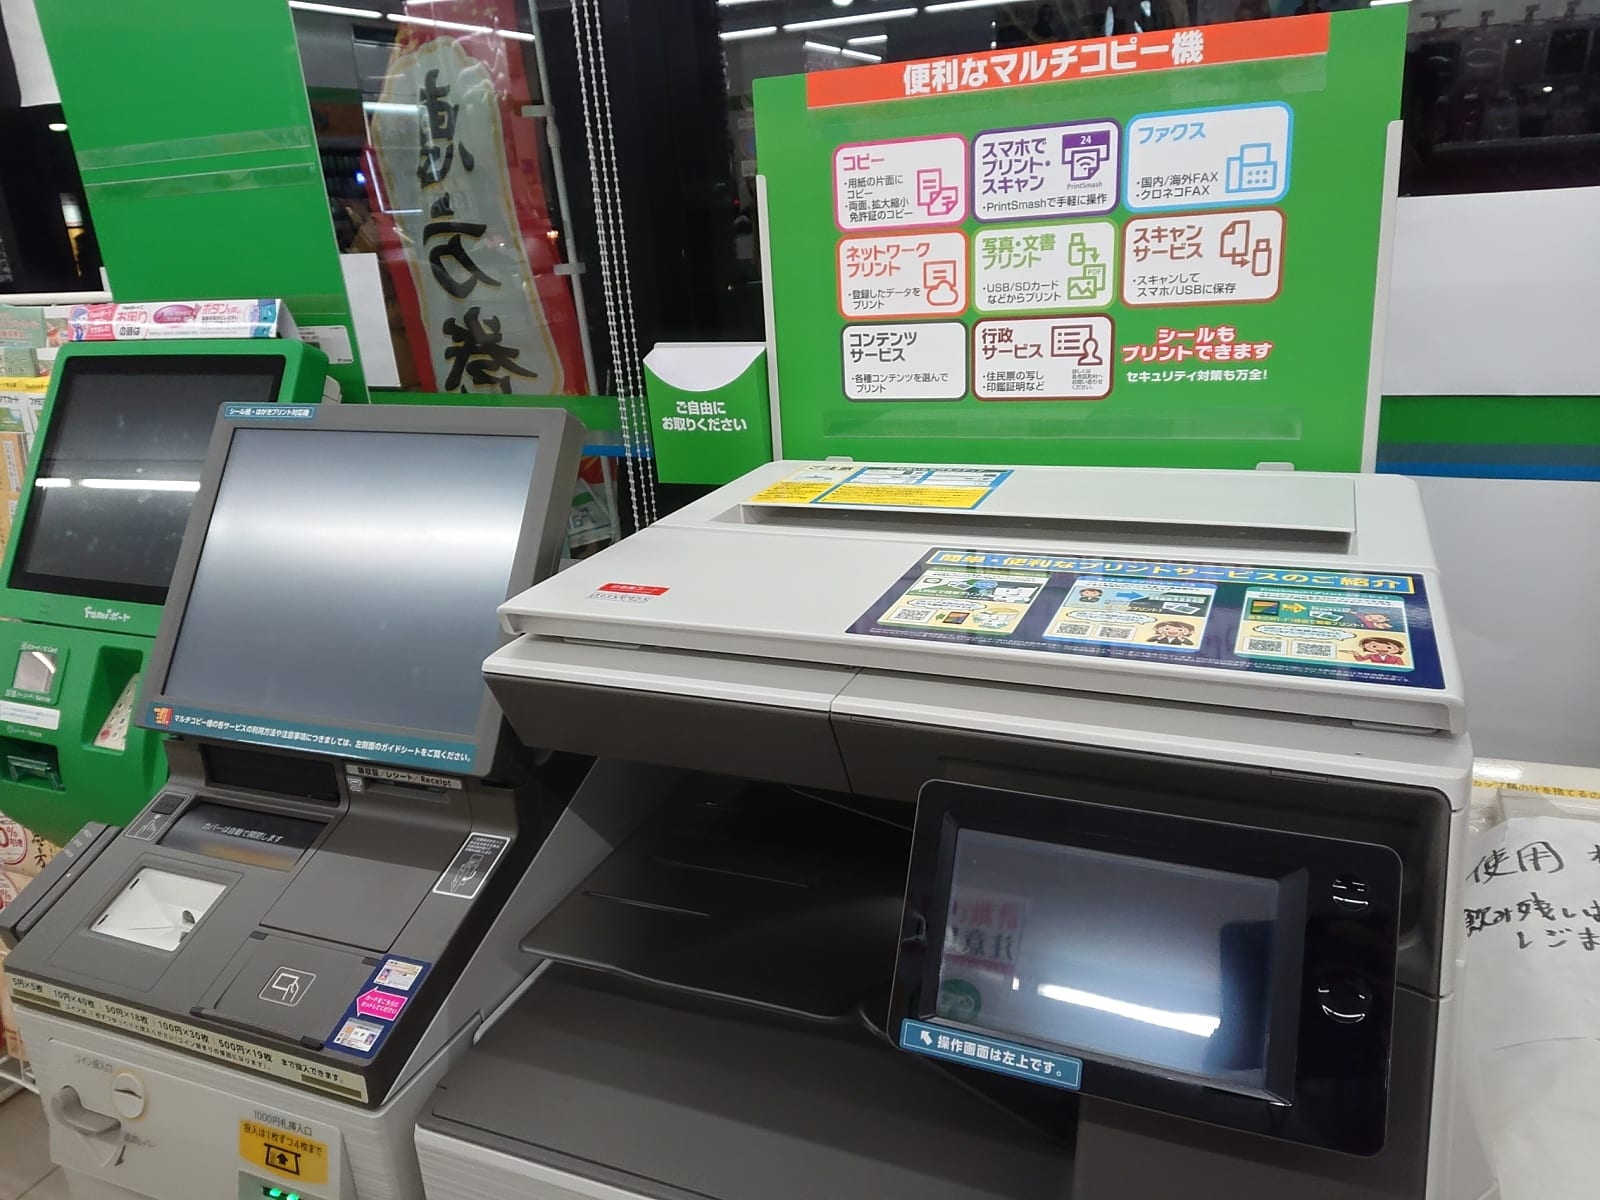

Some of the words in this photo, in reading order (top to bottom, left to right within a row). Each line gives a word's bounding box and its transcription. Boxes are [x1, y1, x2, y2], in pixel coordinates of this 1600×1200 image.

[903, 29, 1204, 96] 便利なマルチコピー機
[1080, 135, 1092, 145] 24
[1137, 122, 1206, 145] ファクス
[982, 137, 1047, 159] スマホで
[843, 153, 885, 171] コピー
[847, 189, 873, 199] コピー
[982, 175, 1045, 195] スキャン
[849, 208, 913, 223] 免許証のコピー
[1133, 224, 1203, 244] スキャン
[846, 242, 931, 262] ネットワーク
[982, 233, 1056, 255] 写真・文書
[1133, 242, 1204, 262] サービス
[846, 261, 902, 279] プリント
[982, 251, 1042, 271] プリント
[1087, 268, 1102, 276] PDF
[987, 291, 1062, 305] などからプリント
[1137, 282, 1237, 298] スマホ/USBに保存
[853, 299, 885, 310] プリント
[850, 331, 918, 347] コンテンツ
[982, 327, 1014, 344] 行政
[1157, 325, 1236, 344] シールも
[850, 347, 906, 363] サービス
[982, 343, 1044, 360] サービス
[1121, 342, 1273, 362] プリントできます
[856, 383, 887, 393] プリント
[675, 400, 727, 415] ご自由に
[661, 416, 748, 432] お取りください
[940, 553, 1402, 591] 簡単・便利なプリントサービスのご紹介
[1465, 841, 1565, 885] 使用
[937, 1034, 1062, 1077] 操作画面は左上です。
